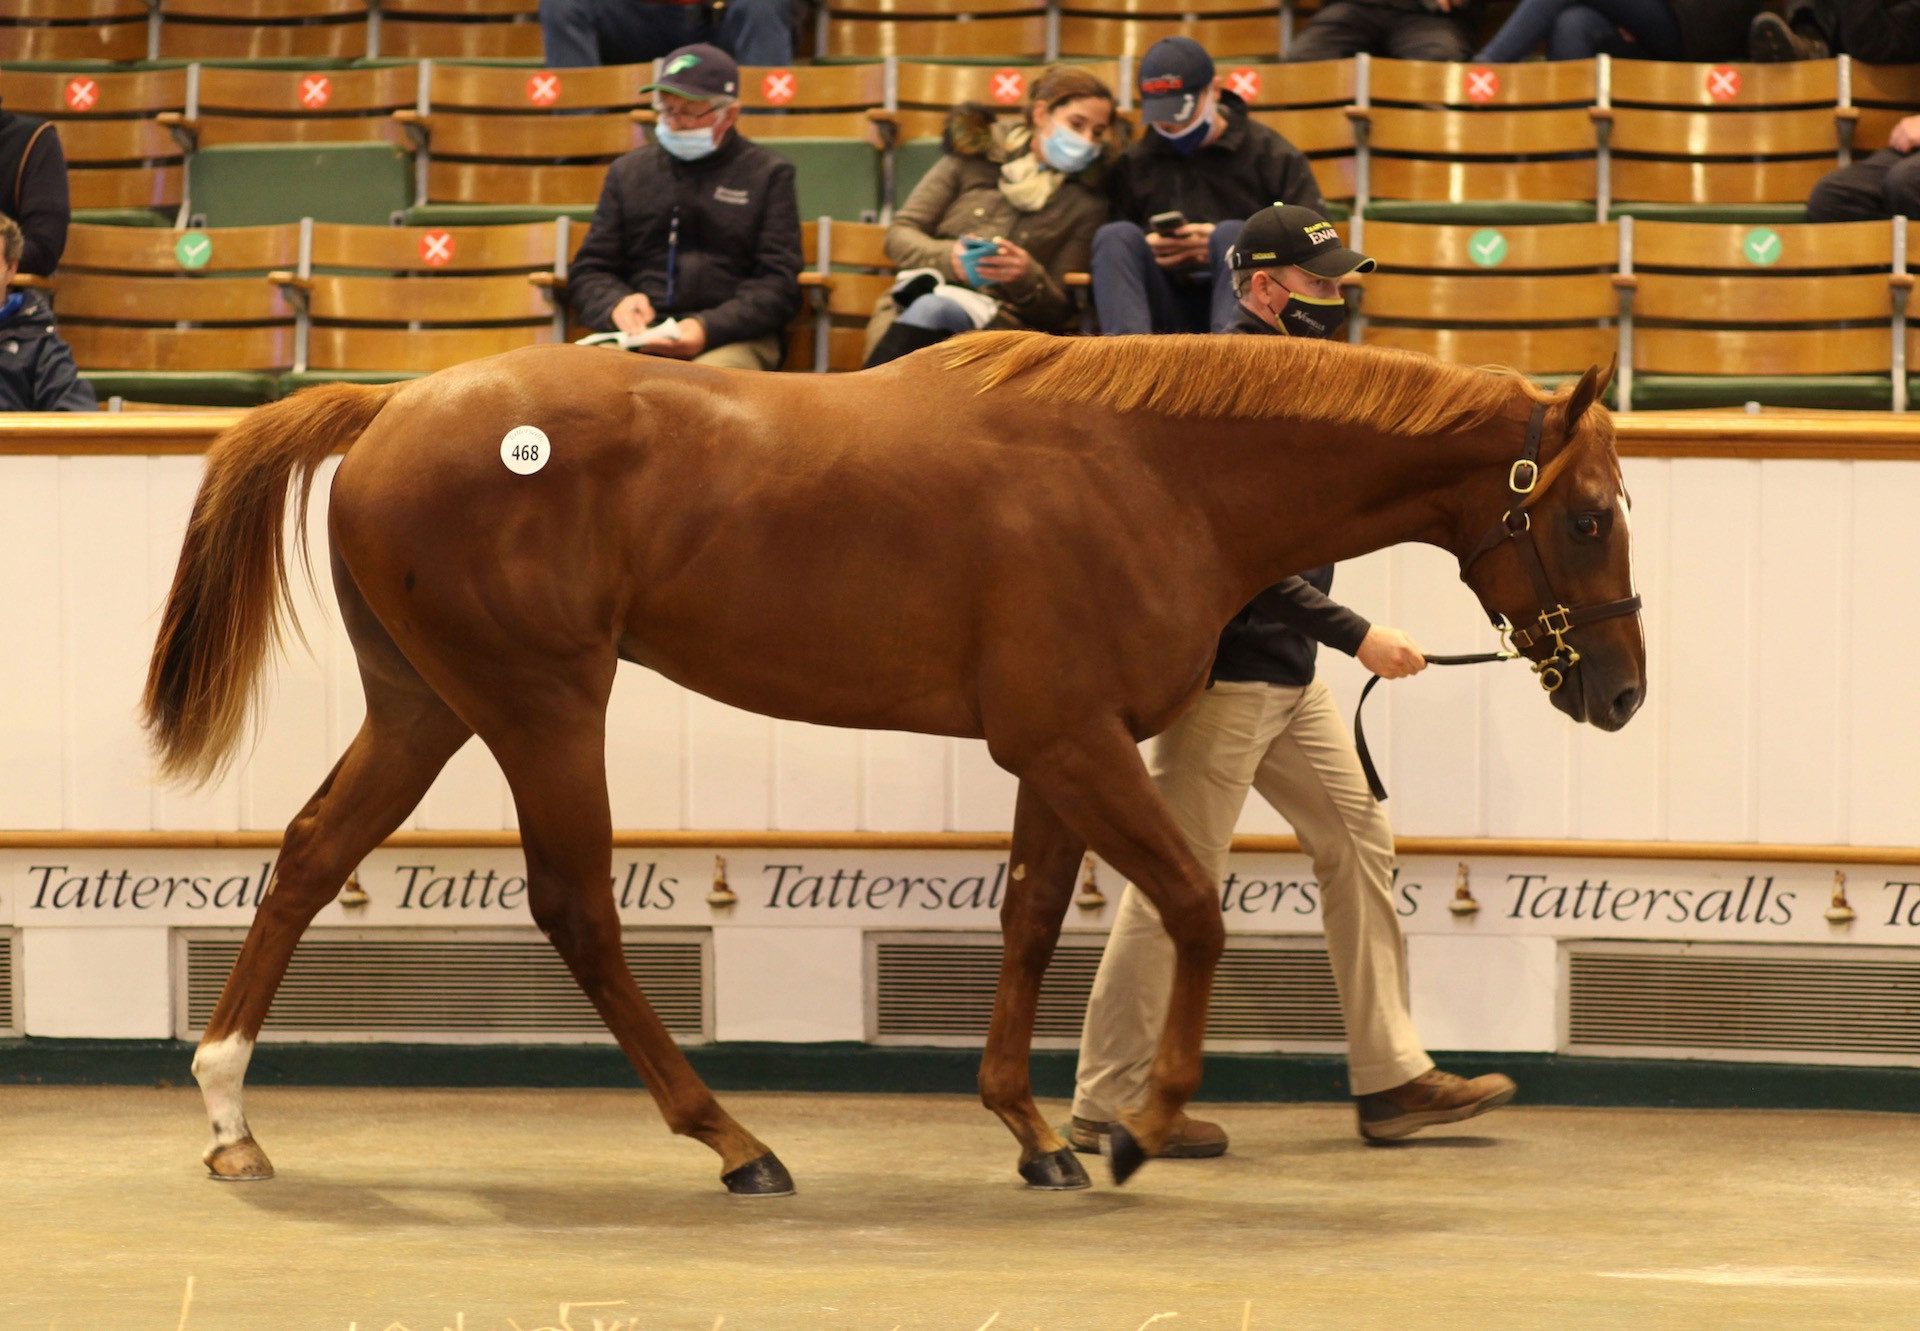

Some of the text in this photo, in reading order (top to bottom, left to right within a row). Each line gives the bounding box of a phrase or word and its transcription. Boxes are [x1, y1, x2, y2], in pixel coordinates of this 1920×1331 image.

[512, 444, 539, 461] 468
[27, 862, 272, 910] Tattersal
[394, 862, 679, 910] Tattells
[762, 862, 1007, 910] Tattersal
[1506, 873, 1797, 926] Tattersalls
